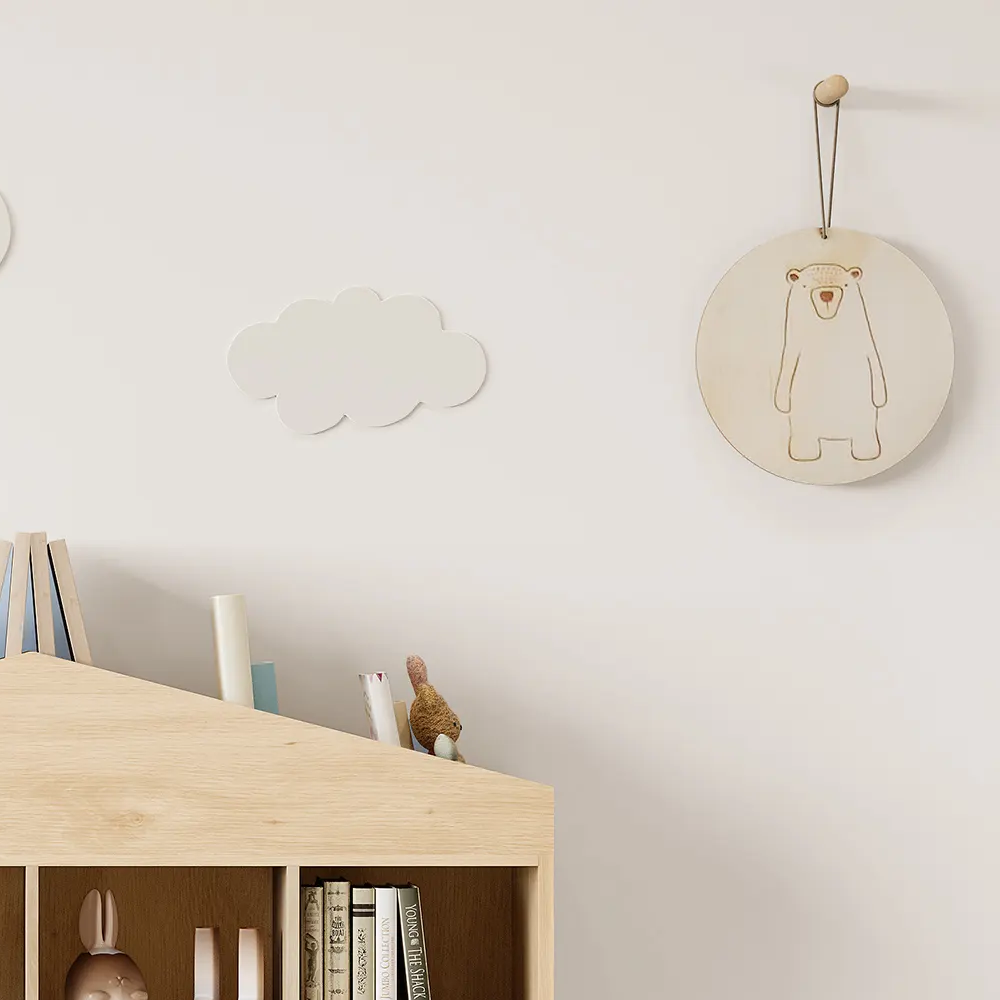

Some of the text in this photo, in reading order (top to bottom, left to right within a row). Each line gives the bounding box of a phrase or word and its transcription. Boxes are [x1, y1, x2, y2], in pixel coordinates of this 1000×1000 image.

[404, 903, 419, 938] YOUNG
[407, 946, 423, 966] THE
[409, 968, 427, 1000] SHACK
